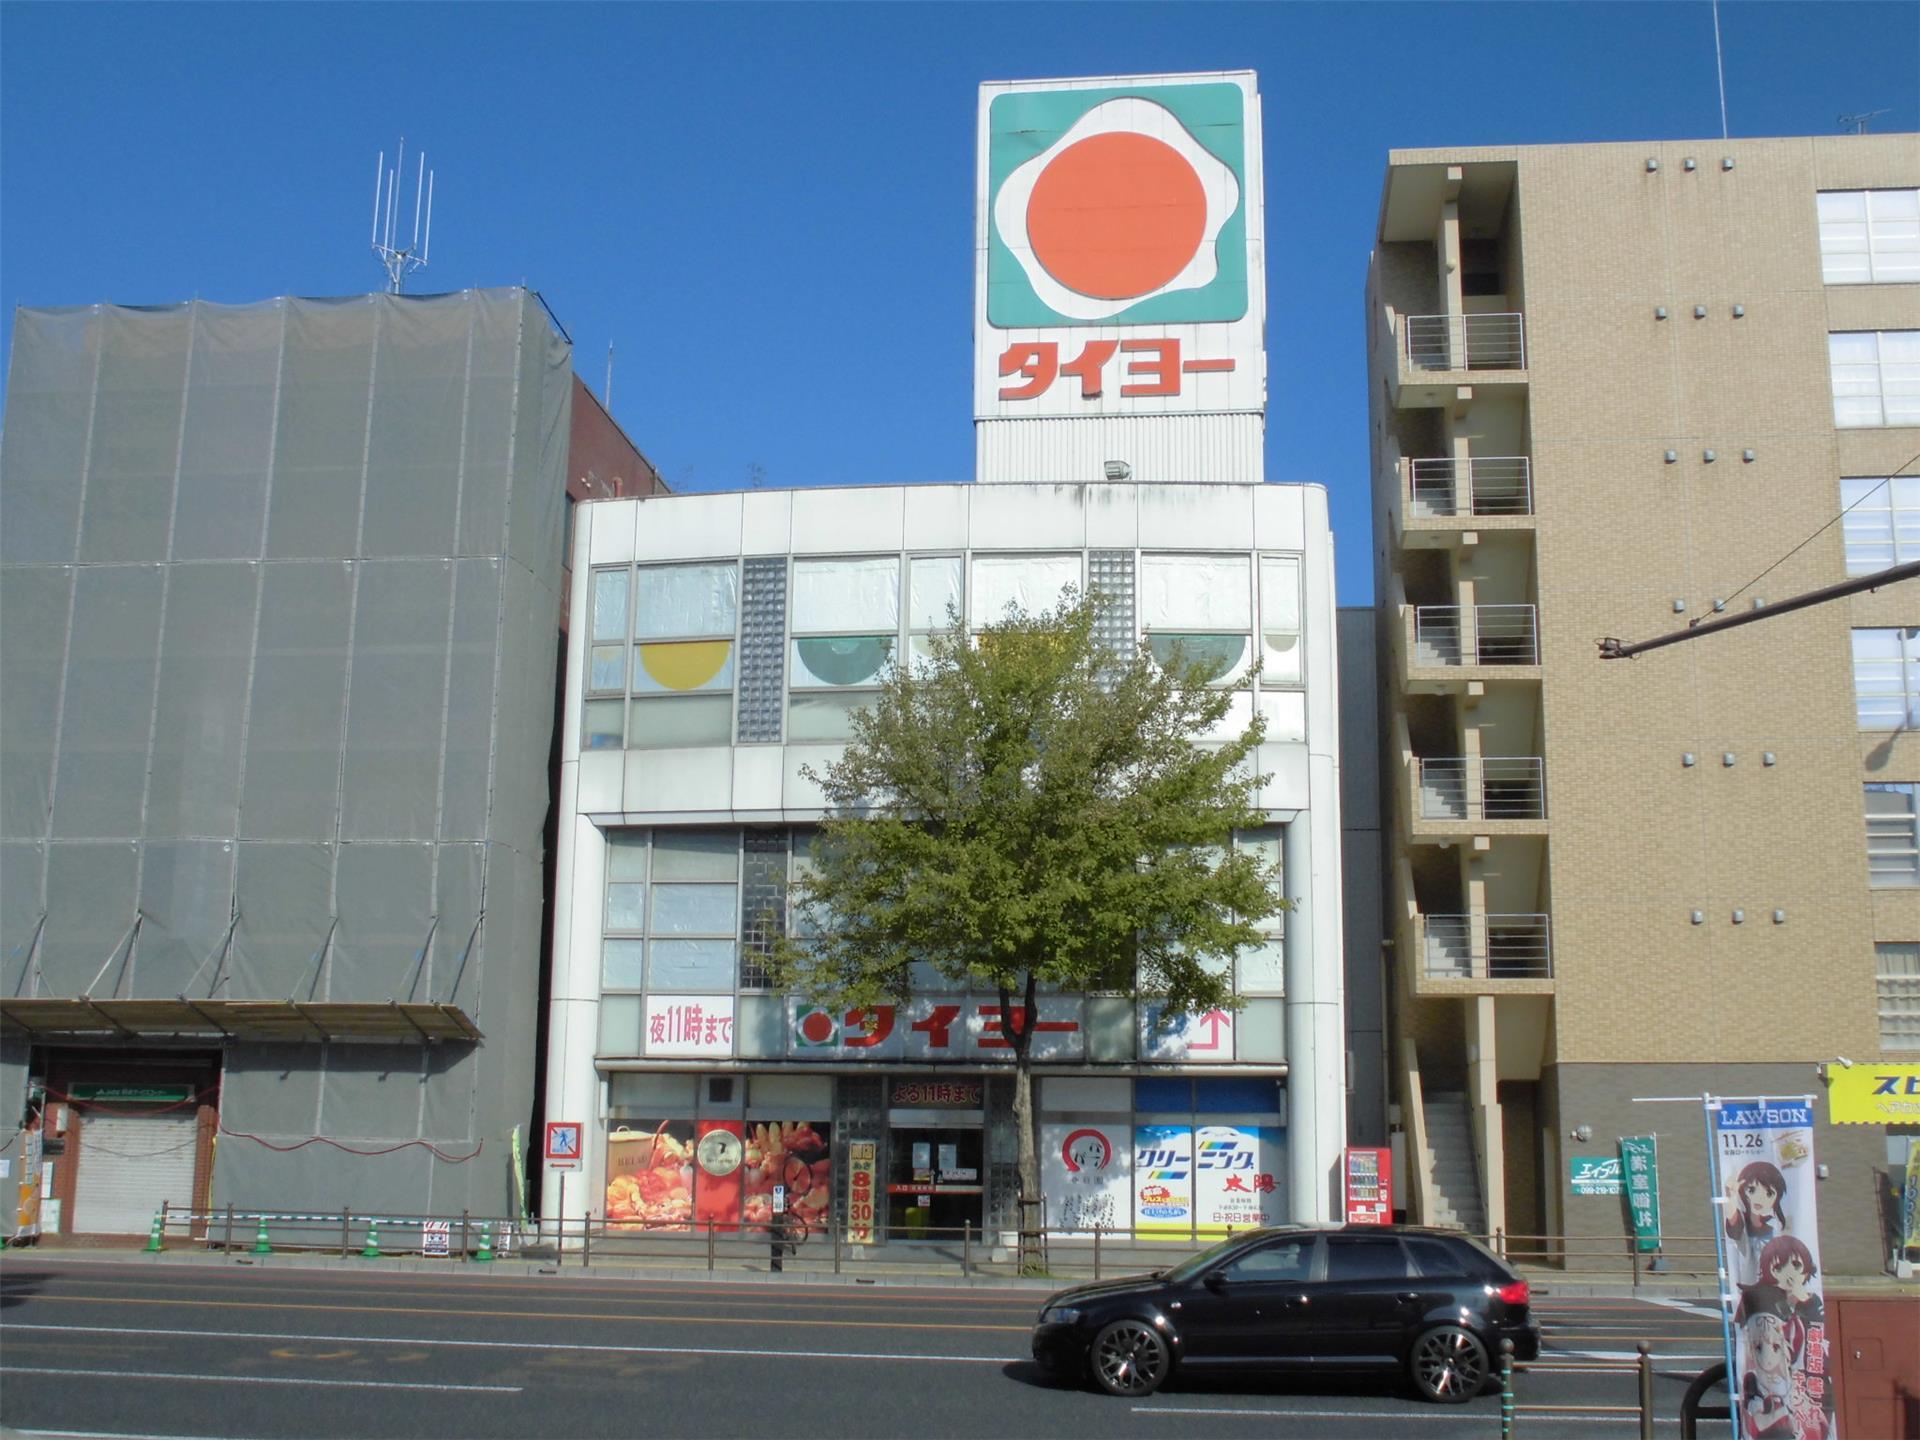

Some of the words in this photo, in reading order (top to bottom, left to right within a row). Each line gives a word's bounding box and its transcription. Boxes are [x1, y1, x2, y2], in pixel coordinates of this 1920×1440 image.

[998, 338, 1236, 401] タイヨー
[650, 1003, 734, 1046] 夜11時まで
[844, 1004, 1079, 1048] タイヨー
[893, 1082, 983, 1104] よる11時まで
[1721, 1108, 1808, 1126] LAWSON
[1723, 1134, 1763, 1148] 11.26
